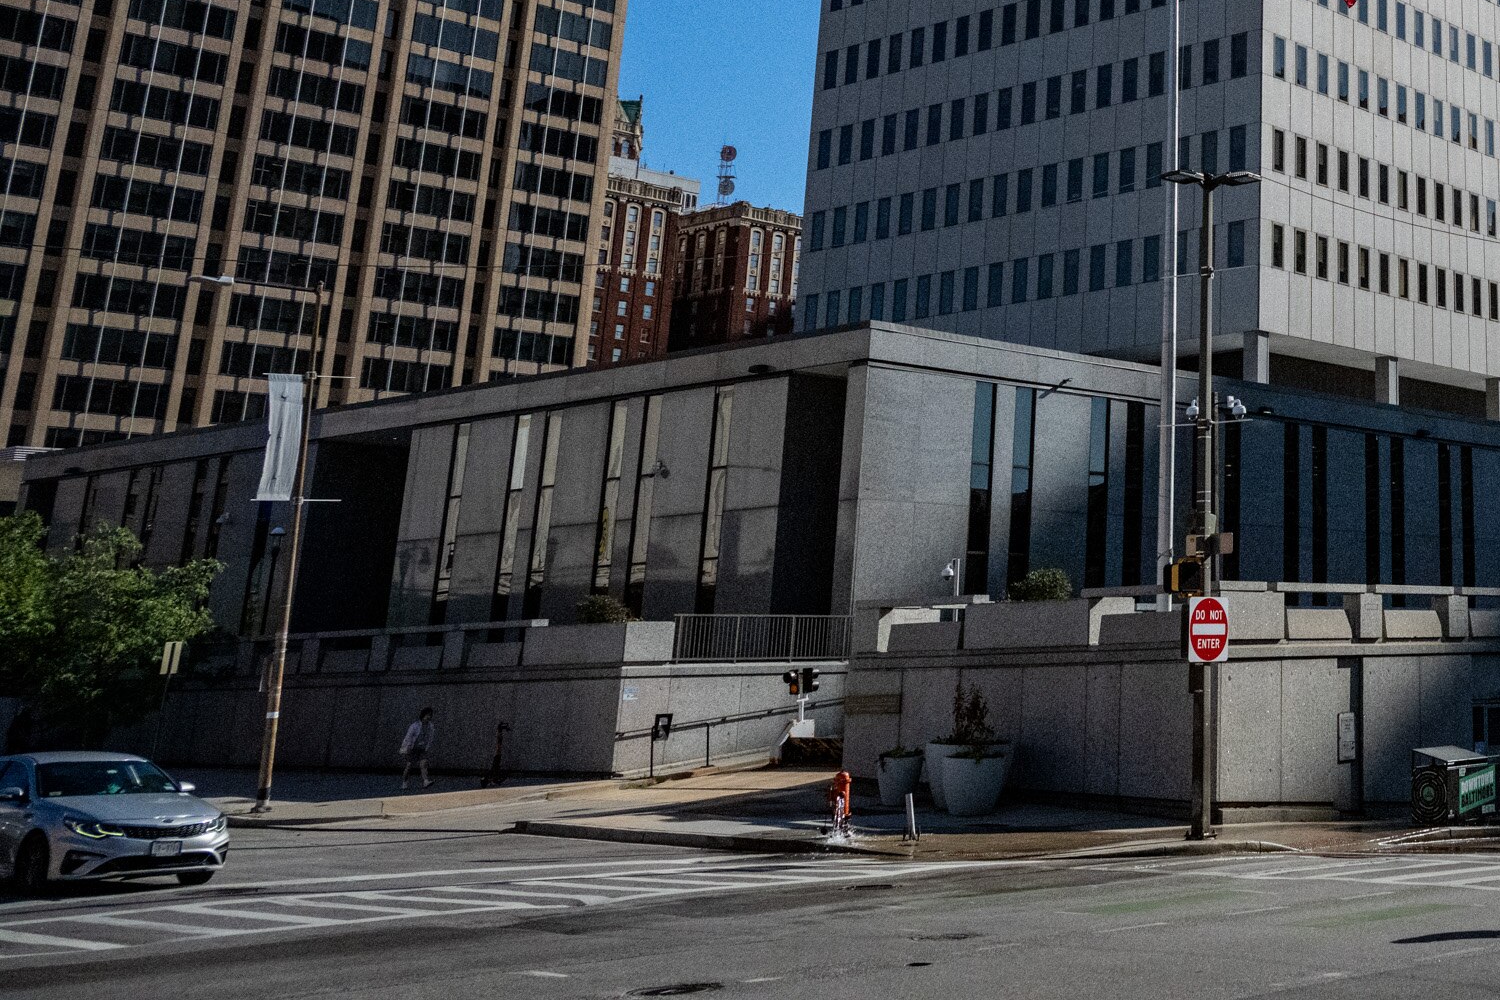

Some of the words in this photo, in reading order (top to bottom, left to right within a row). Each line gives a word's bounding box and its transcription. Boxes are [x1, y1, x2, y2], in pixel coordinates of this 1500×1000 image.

[1196, 609, 1205, 620] DO
[1210, 609, 1223, 620] NOT
[1197, 638, 1220, 649] ENTER
[1461, 770, 1494, 795] DOWNTOWN
[1461, 783, 1494, 808] BALTIMORE
